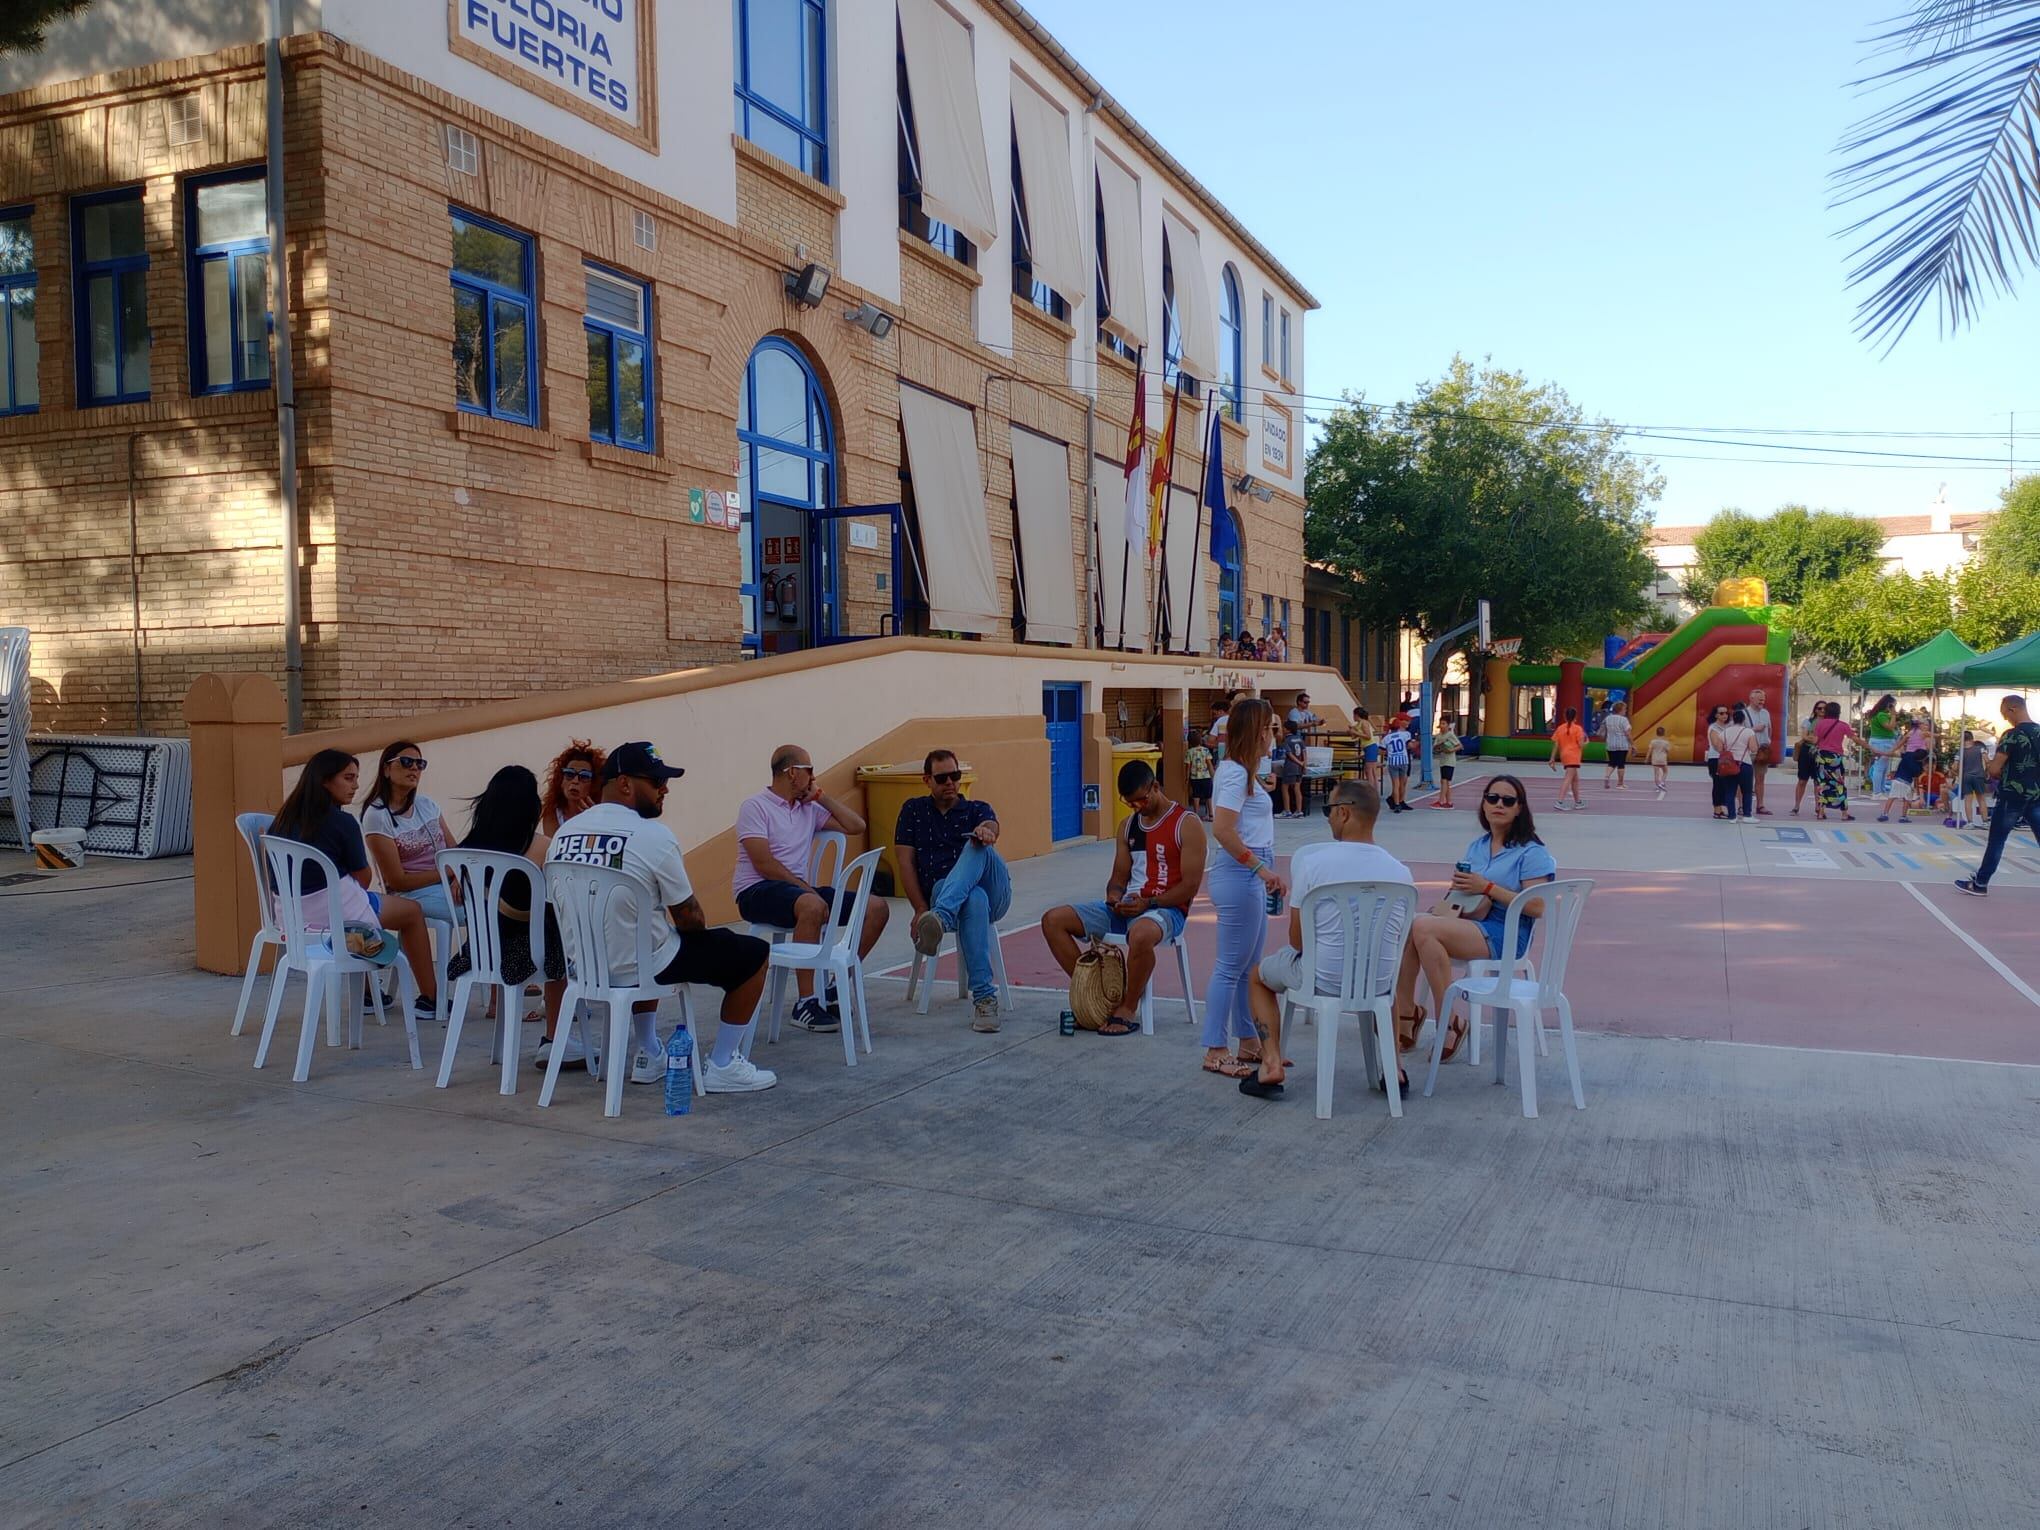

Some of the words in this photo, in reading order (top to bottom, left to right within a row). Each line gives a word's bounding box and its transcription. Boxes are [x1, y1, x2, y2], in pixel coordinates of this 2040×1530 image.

[468, 0, 628, 112] FUERTES
[496, 0, 612, 66] LORIA
[557, 835, 624, 855] HELLO
[1155, 843, 1168, 886] DUCATI
